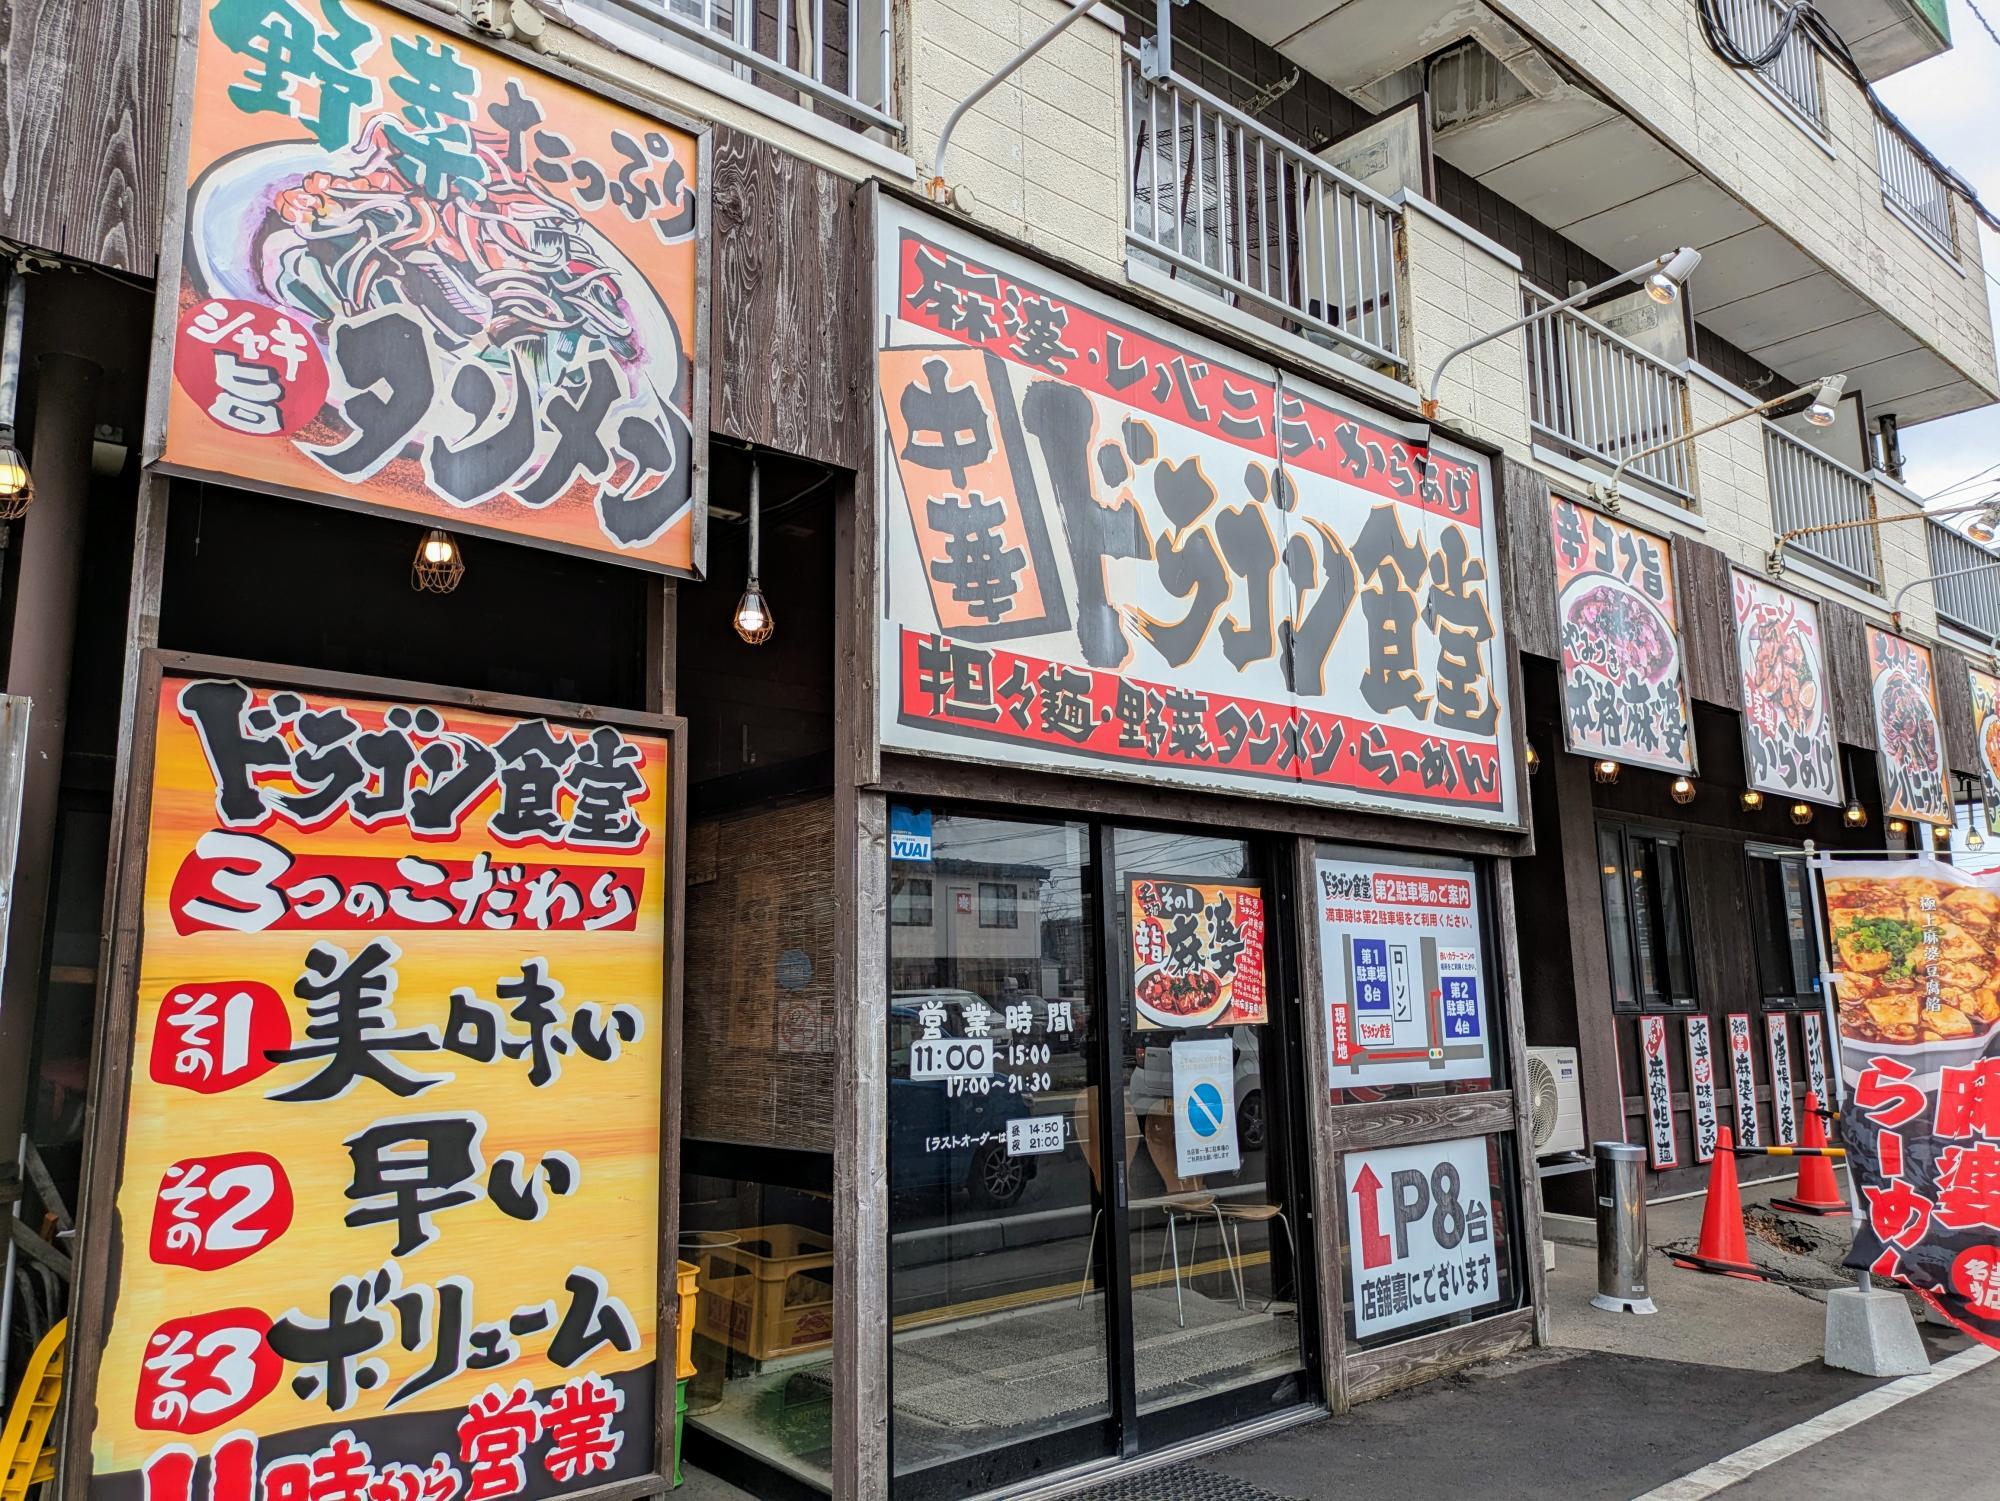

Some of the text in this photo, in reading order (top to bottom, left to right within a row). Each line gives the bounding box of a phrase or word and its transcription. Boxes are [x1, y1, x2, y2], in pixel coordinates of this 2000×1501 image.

[208, 0, 696, 246] 野菜たっぷり
[186, 300, 309, 383] シャキ
[292, 308, 694, 549] タンメン
[898, 356, 1030, 626] 中華
[1018, 376, 1504, 738] ドラゴン食堂
[178, 679, 648, 855] ドラゴン食堂
[1750, 720, 1834, 797] からあげ
[182, 829, 637, 934] 3つのこだわり
[892, 841, 929, 858] YUAI
[1320, 870, 1470, 906] ドラゴン食堂 第2駐車場のご案内
[1325, 907, 1474, 929] 満車時は第2駐車場をご利用ください。
[1356, 966, 1387, 983] 駐車場
[1361, 948, 1379, 965] 第1
[1393, 951, 1407, 1018] ローソン
[1450, 981, 1469, 999] 第2
[262, 937, 645, 1103] 美味い
[918, 1000, 1075, 1040] 営業時間
[1363, 985, 1382, 1002] 8台
[1446, 1000, 1476, 1016] 駐車場
[1334, 1007, 1349, 1060] 現在地
[1360, 1022, 1392, 1040] ドラゴン食堂
[1454, 1020, 1470, 1035] 4台
[1011, 1125, 1021, 1136] 昼
[1029, 1121, 1060, 1135] 14:50
[1011, 1136, 1060, 1152] 夜 21:00
[159, 1163, 276, 1256] その2
[342, 1110, 582, 1258] 早い
[1391, 1161, 1489, 1259] P8台
[1360, 1253, 1491, 1321] 店舗裏にございます
[266, 1260, 641, 1412] ボリューム
[144, 1326, 262, 1428] その3
